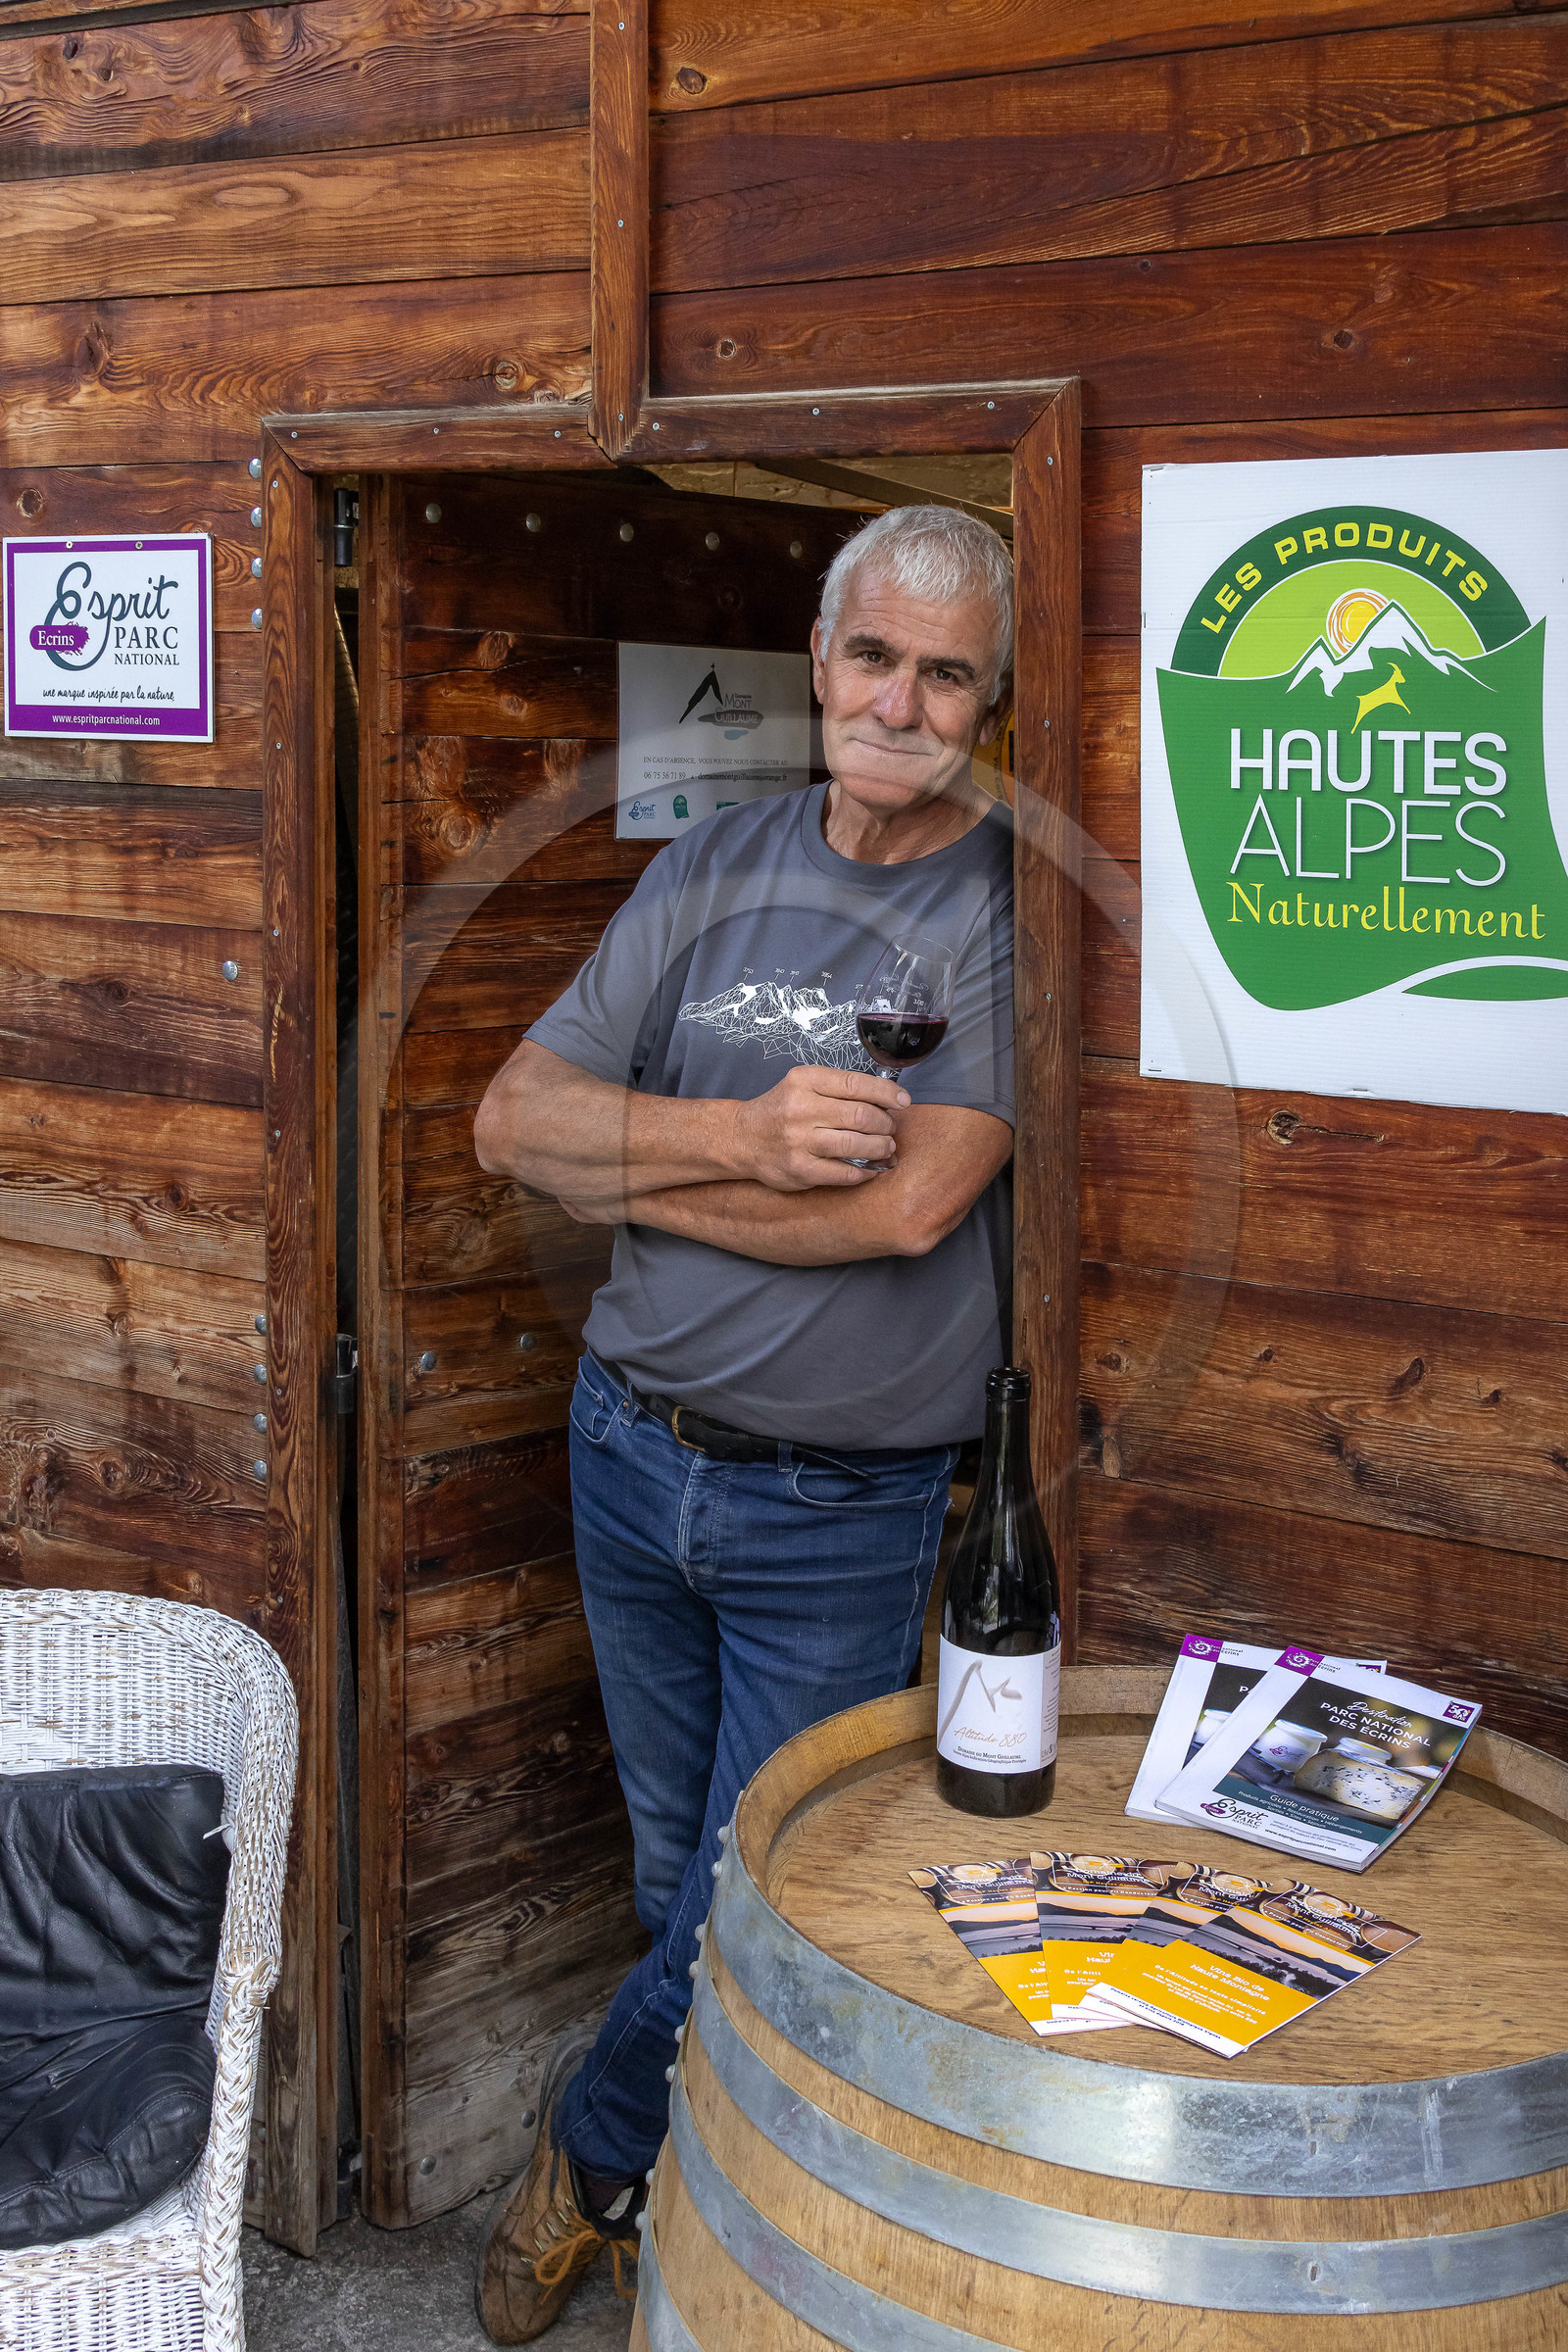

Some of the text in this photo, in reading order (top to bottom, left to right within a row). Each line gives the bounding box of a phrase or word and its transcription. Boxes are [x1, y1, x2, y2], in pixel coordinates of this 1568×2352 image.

[1200, 521, 1489, 634] LES PRODUITS
[44, 561, 178, 671] Esprit
[37, 629, 74, 647] Ecrins
[114, 626, 178, 650] PARC
[114, 653, 179, 666] NATIONAL
[42, 689, 56, 698] une
[58, 688, 85, 702] marque
[87, 686, 119, 703] inspirée
[120, 689, 135, 703] par
[136, 685, 146, 700] la
[52, 713, 161, 726] www.espritparcnational.com
[1230, 727, 1508, 797] HAUTES
[1229, 794, 1507, 888] ALPES
[1225, 882, 1546, 940] Naturellement
[1320, 1702, 1431, 1747] PARC NATIONAL
[1347, 1701, 1412, 1729] Destination
[954, 1726, 1027, 1747] Altitude 880
[1328, 1714, 1411, 1749] DES ÉCRINS
[1205, 1798, 1268, 1819] Esprit
[1238, 1790, 1259, 1802] Produits
[1258, 1798, 1282, 1811] agricoles
[1287, 1807, 1319, 1822] Restauration
[1269, 1793, 1340, 1824] Guide pratique
[1235, 1814, 1262, 1828] PARC
[1264, 1828, 1337, 1852] www.espritparcnational.com
[956, 1882, 983, 1890] Mont
[1066, 1871, 1094, 1880] Mont
[1199, 1886, 1225, 1897] Mont
[1210, 1884, 1253, 1898] Domain
[1285, 1901, 1311, 1916] Mont
[1189, 1963, 1271, 2002] Haute Montagne
[1209, 1965, 1265, 1992] Vins Bio de
